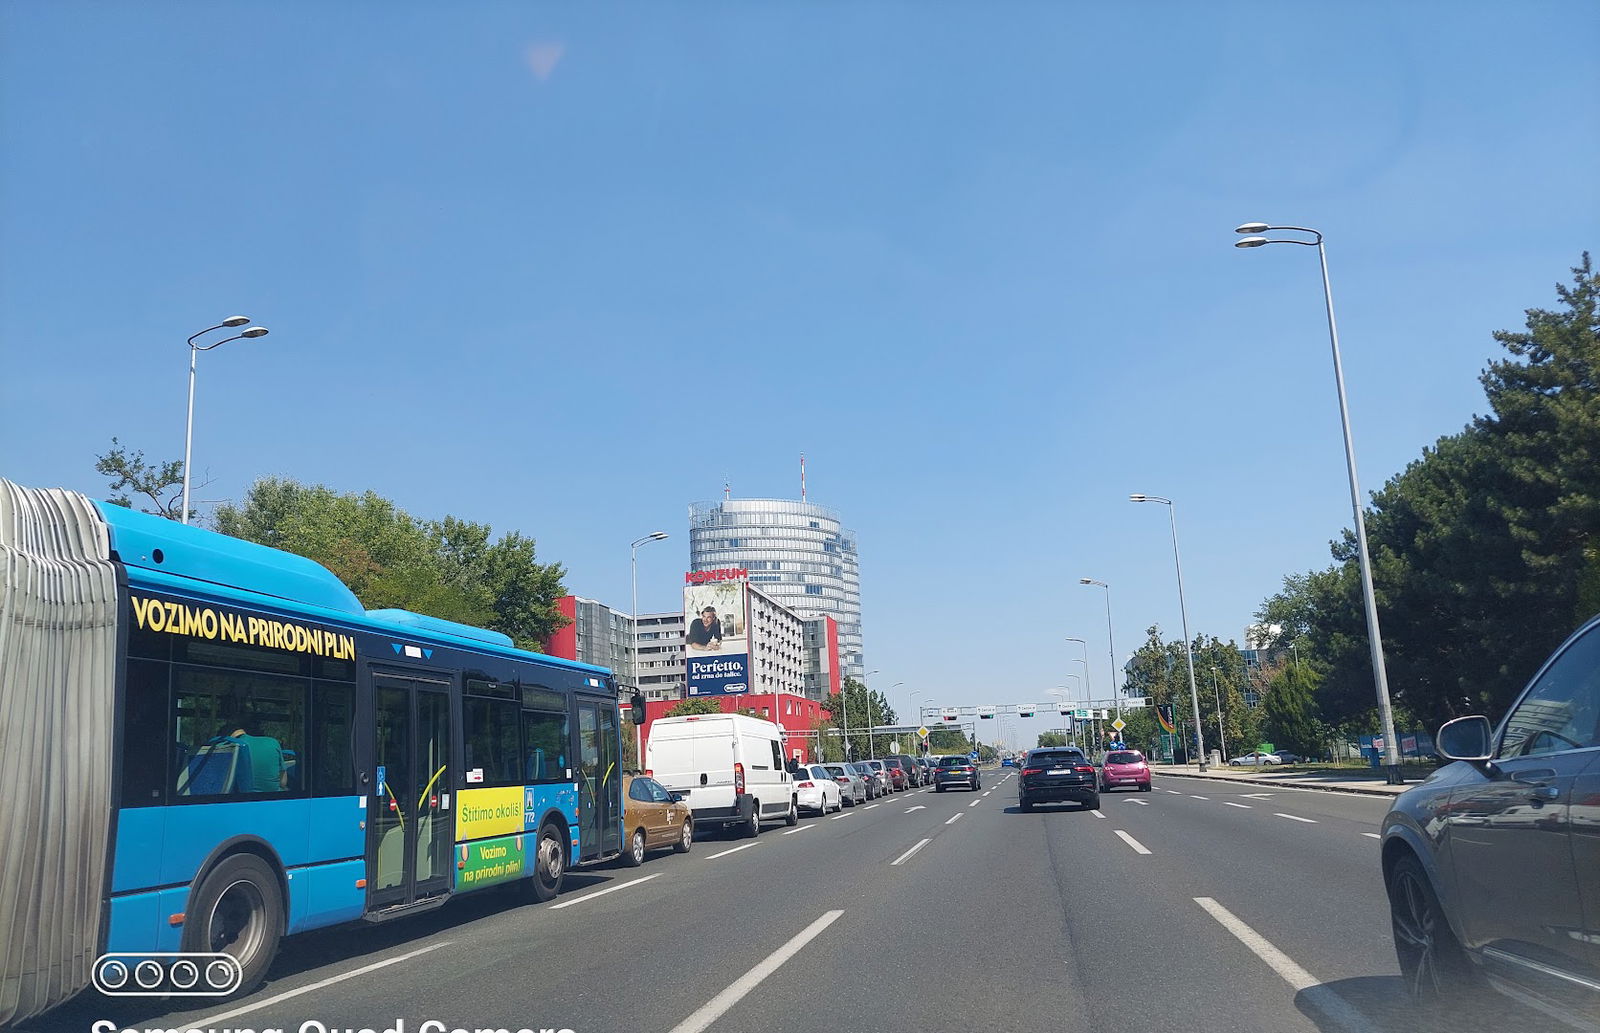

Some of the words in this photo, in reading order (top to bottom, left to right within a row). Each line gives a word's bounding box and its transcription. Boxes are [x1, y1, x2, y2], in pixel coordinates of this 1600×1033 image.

[686, 568, 748, 583] KONZUM
[131, 596, 218, 639] VOZIMO
[219, 611, 248, 643] NA
[248, 617, 323, 656] PRIRODNI
[325, 631, 355, 662] PLIN
[691, 660, 744, 673] Perfetto,
[715, 671, 723, 679] do
[462, 804, 494, 823] Štitimo
[495, 803, 522, 818] okoliš!
[525, 812, 535, 823] 772
[480, 845, 507, 860] Vozimo
[464, 871, 474, 883] na
[475, 862, 505, 883] prirodni
[505, 860, 521, 877] plin!
